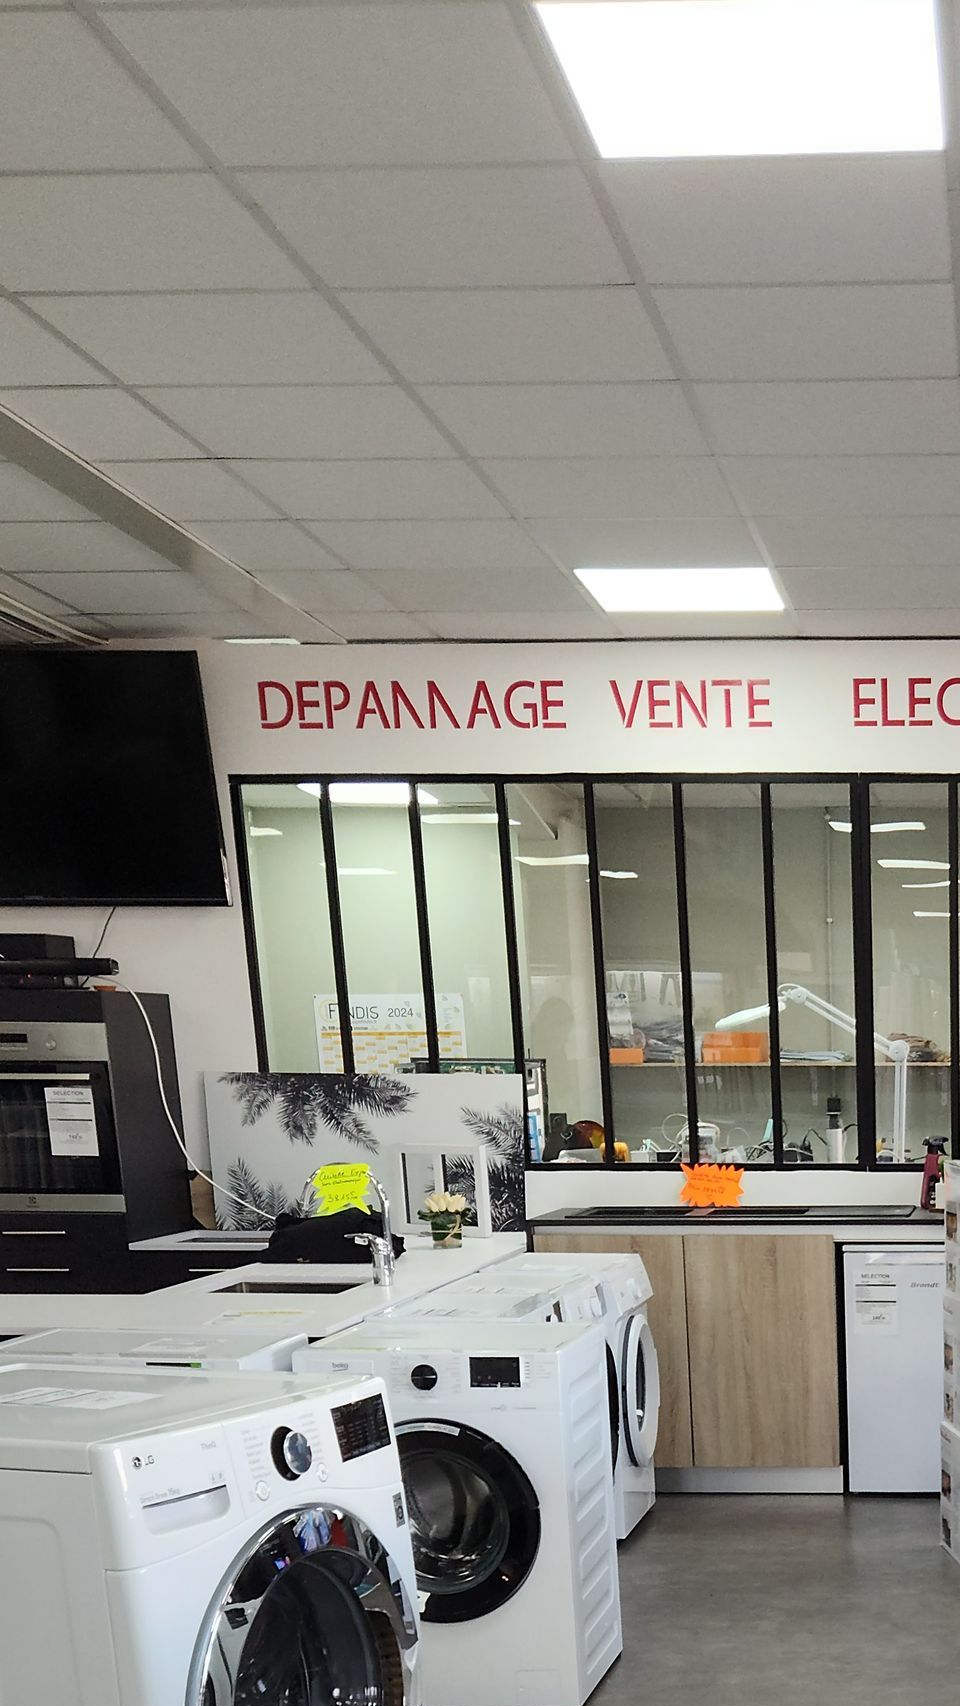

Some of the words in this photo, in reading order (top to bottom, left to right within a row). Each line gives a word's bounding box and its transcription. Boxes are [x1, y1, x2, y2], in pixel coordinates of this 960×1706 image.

[257, 679, 567, 730] DEPANNAGE
[608, 678, 774, 729] VENTE
[387, 1007, 414, 1018] 2024
[145, 1455, 155, 1466] LG
